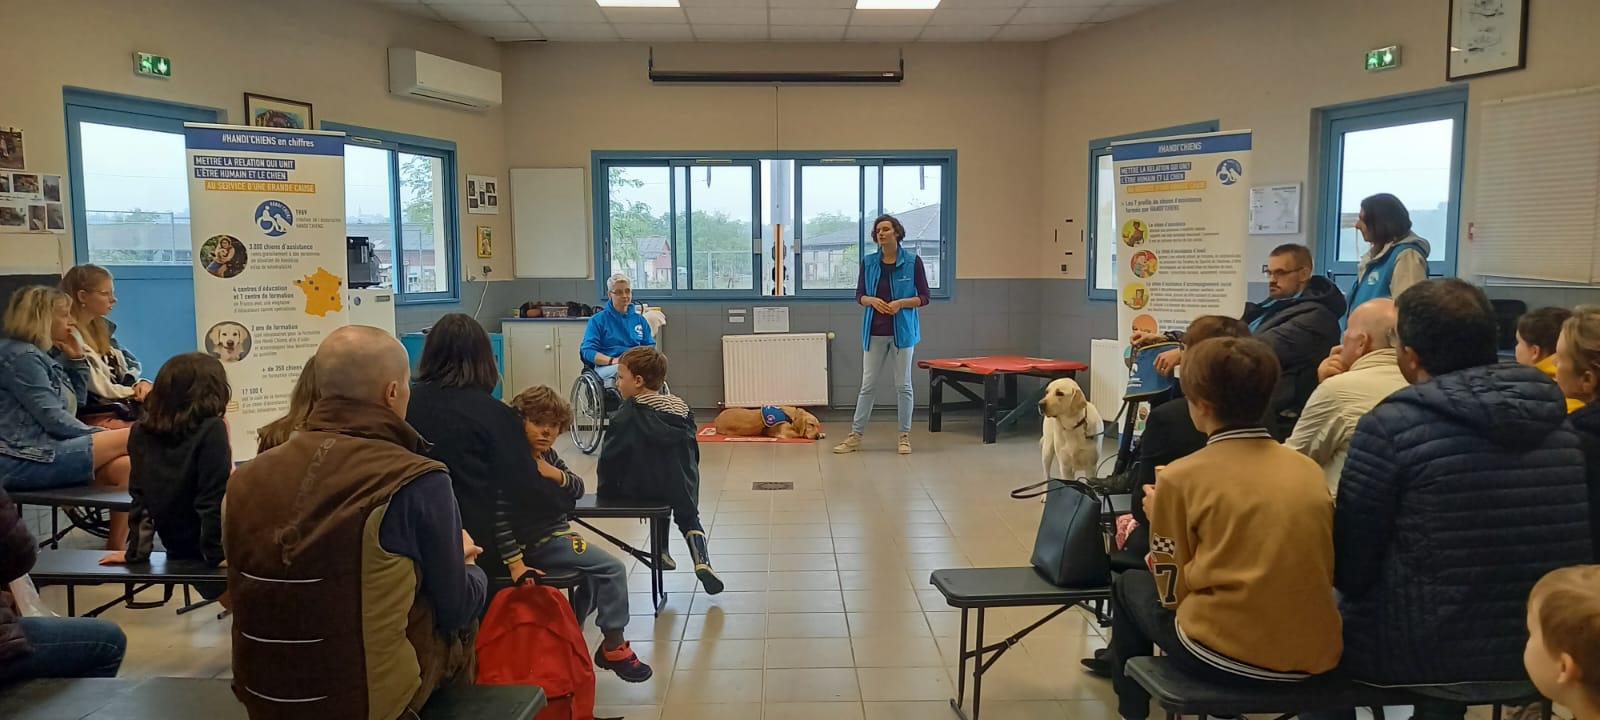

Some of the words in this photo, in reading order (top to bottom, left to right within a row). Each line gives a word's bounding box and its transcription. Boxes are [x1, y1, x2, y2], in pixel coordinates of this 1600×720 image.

[222, 133, 276, 146] #HANDI'CHIENS
[288, 138, 314, 148] chiffres
[196, 156, 222, 166] METTRE
[224, 158, 232, 166] LA
[234, 158, 264, 168] RELATION
[266, 159, 278, 168] QUI
[279, 160, 294, 169] UNIT
[220, 169, 246, 178] HUMAIN
[248, 170, 256, 178] ET
[258, 171, 266, 179] LE
[266, 171, 286, 180] CHIEN
[218, 182, 246, 190] SERVICE
[268, 184, 292, 192] GRANDE
[294, 184, 314, 193] CAUSE
[1154, 562, 1178, 606] 7
